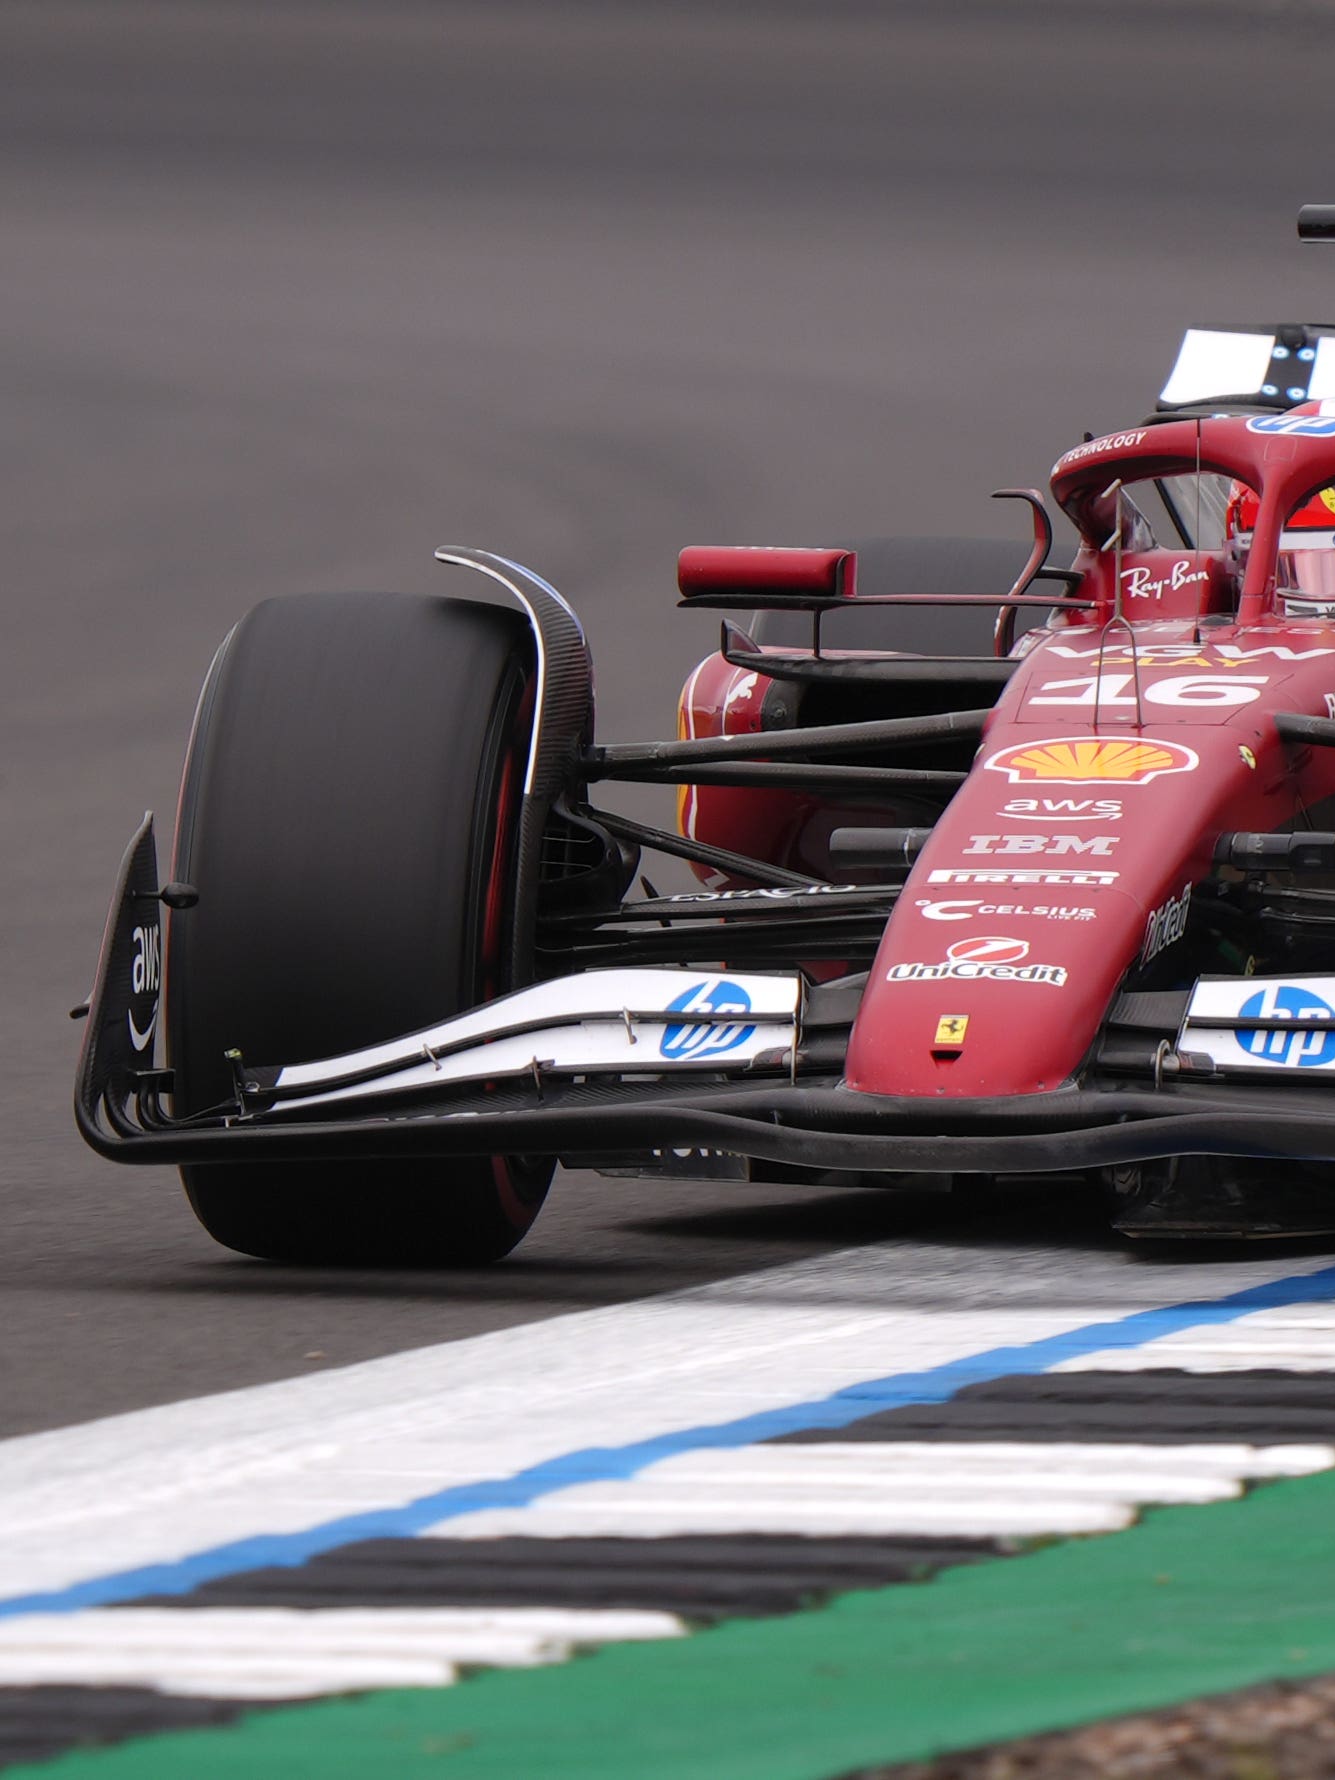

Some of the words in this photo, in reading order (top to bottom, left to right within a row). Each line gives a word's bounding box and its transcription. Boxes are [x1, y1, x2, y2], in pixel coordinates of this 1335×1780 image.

[1063, 431, 1147, 463] TECHNOLOGY
[1120, 560, 1209, 599] Ray-Ban
[1090, 657, 1260, 668] PLAY
[1028, 674, 1270, 706] 16
[1003, 798, 1123, 812] aws
[962, 835, 1120, 855] IBM
[927, 869, 1120, 885] PIRELLI
[978, 905, 1095, 917] CELSIUS
[132, 926, 160, 994] aws
[889, 963, 1066, 985] UniCredit
[664, 980, 748, 1060] hp
[1250, 986, 1331, 1067] hp
